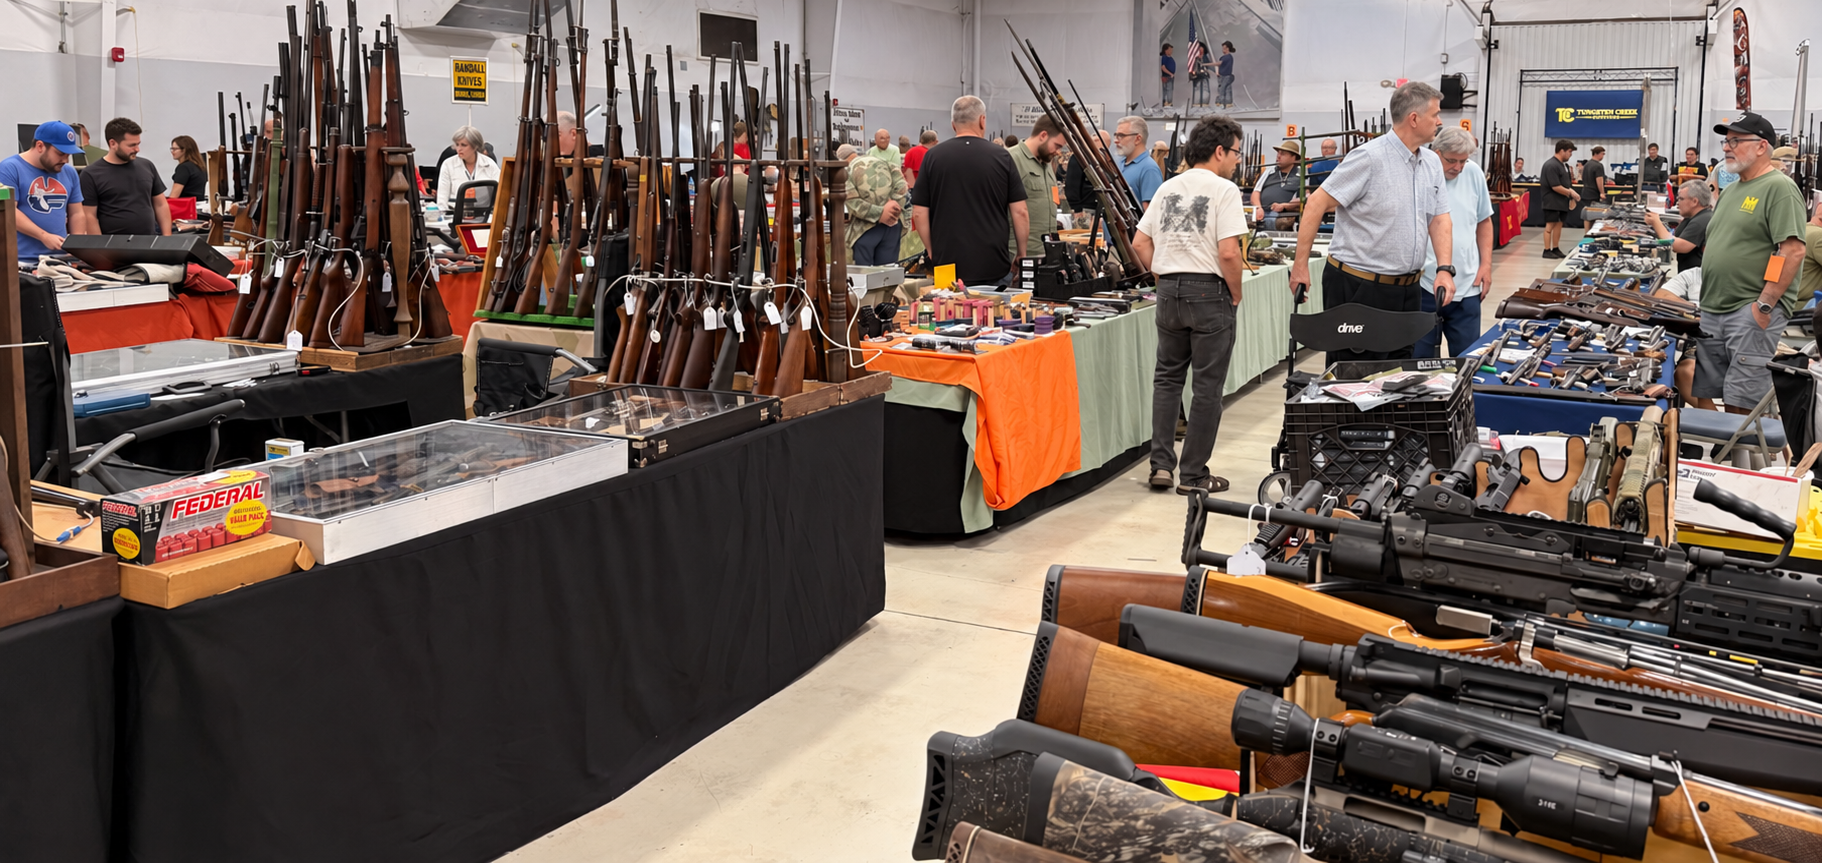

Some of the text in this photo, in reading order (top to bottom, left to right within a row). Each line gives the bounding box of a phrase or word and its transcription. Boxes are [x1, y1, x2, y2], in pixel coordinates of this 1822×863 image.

[1288, 126, 1295, 136] B
[1337, 322, 1363, 334] drive
[171, 481, 265, 521] FEDERAL
